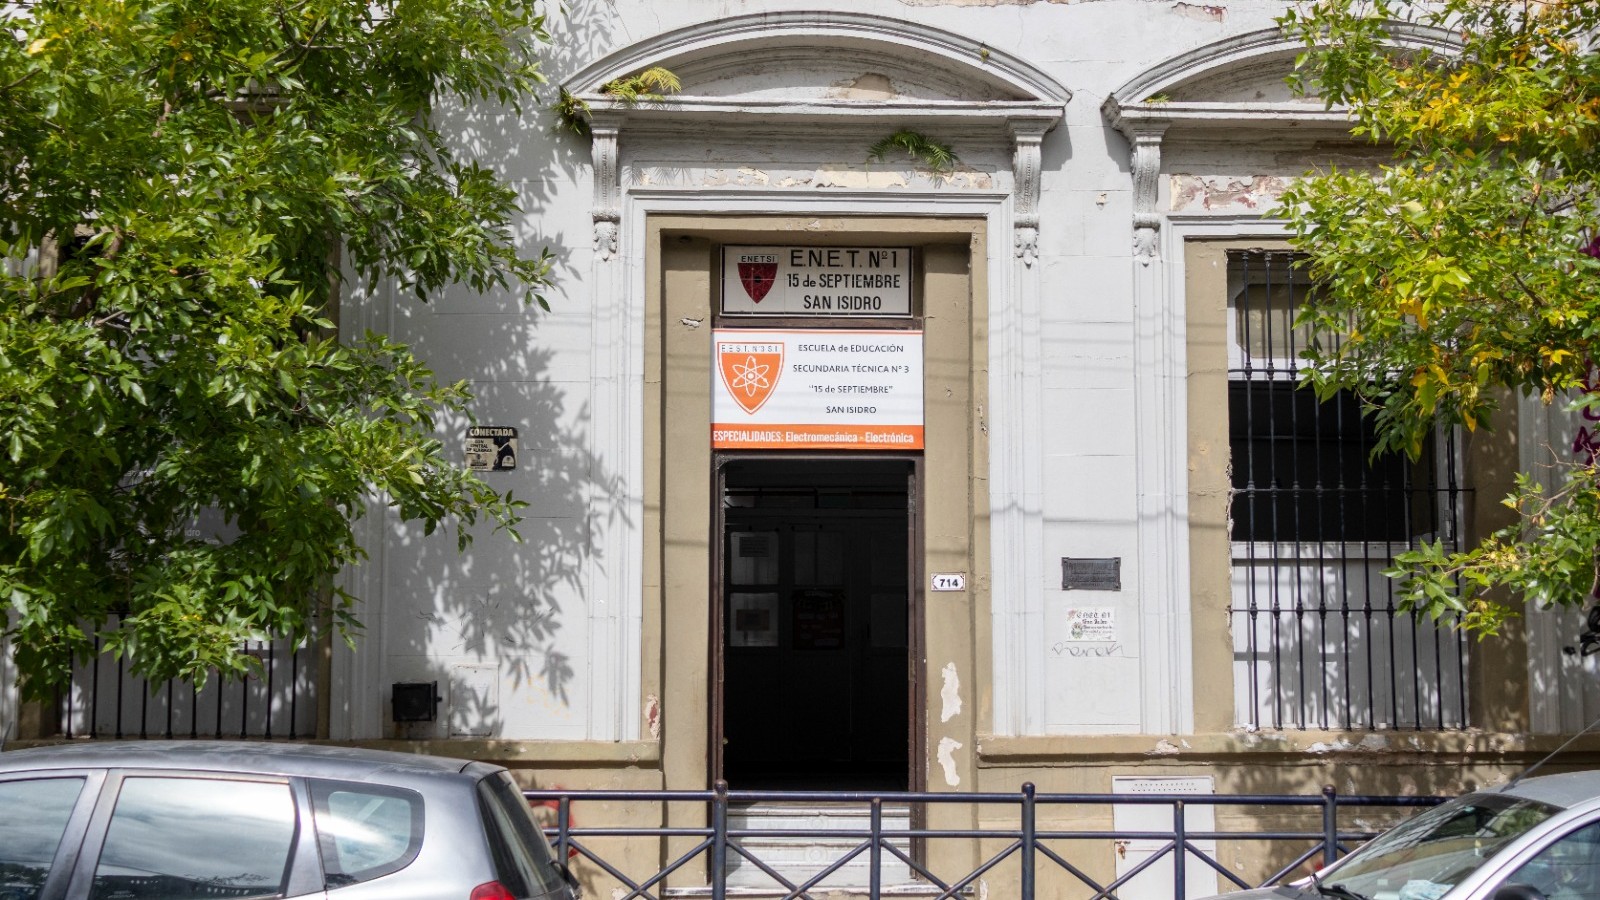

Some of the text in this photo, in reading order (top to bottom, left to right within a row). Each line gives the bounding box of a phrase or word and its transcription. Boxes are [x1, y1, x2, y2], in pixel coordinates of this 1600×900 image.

[741, 255, 775, 263] ENETSI
[790, 249, 862, 268] E.N.E.T.
[891, 251, 897, 268] 1
[786, 273, 901, 288] 15 de SEPTIEMBRE
[804, 295, 881, 310] SAN ISIDRO
[851, 343, 904, 353] EDUCACIÓN
[851, 363, 889, 373] TÉCNICA
[904, 365, 909, 373] 3
[825, 385, 835, 393] de
[826, 406, 877, 414] SAN ISIDRO
[469, 428, 513, 436] CONECTADA
[714, 431, 784, 442] ESPECIALIDADES:
[786, 431, 858, 443] Electromecánica
[865, 432, 914, 443] Electrónica
[940, 579, 959, 587] 714
